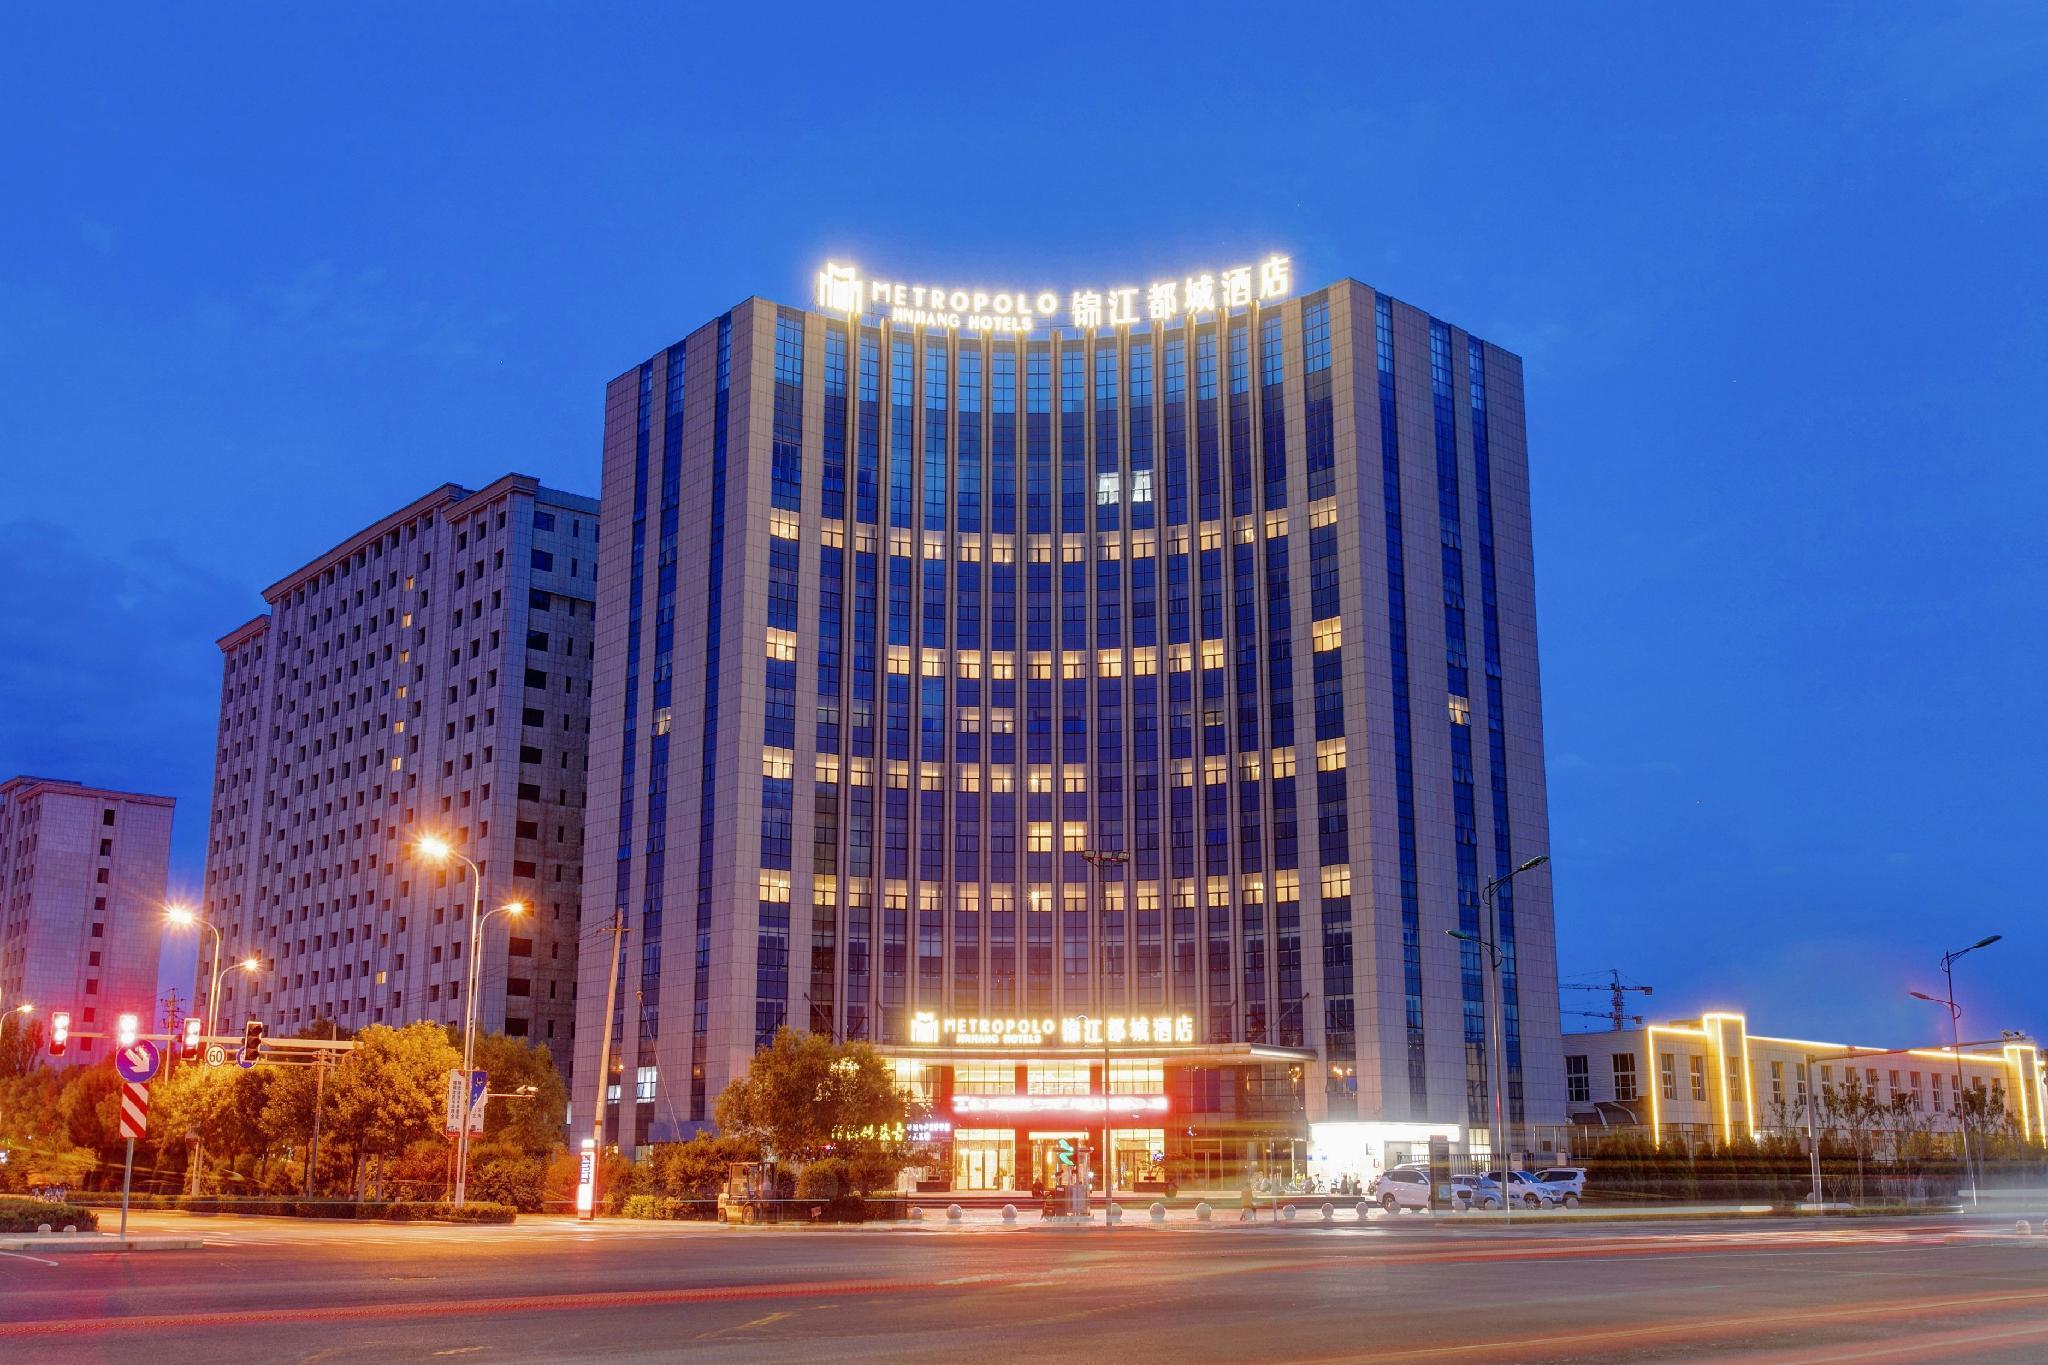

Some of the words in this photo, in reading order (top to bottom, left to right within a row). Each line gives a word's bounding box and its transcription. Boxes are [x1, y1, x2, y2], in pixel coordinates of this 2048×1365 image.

[871, 280, 1058, 314] METROPOLO
[1072, 256, 1289, 328] 锦江都城酒店
[892, 306, 961, 328] JINJIANG
[968, 315, 1032, 332] HOTELS
[944, 1018, 1055, 1034] METROPOLO
[1061, 1014, 1194, 1043] 锦江都城酒店
[209, 1050, 222, 1063] 60
